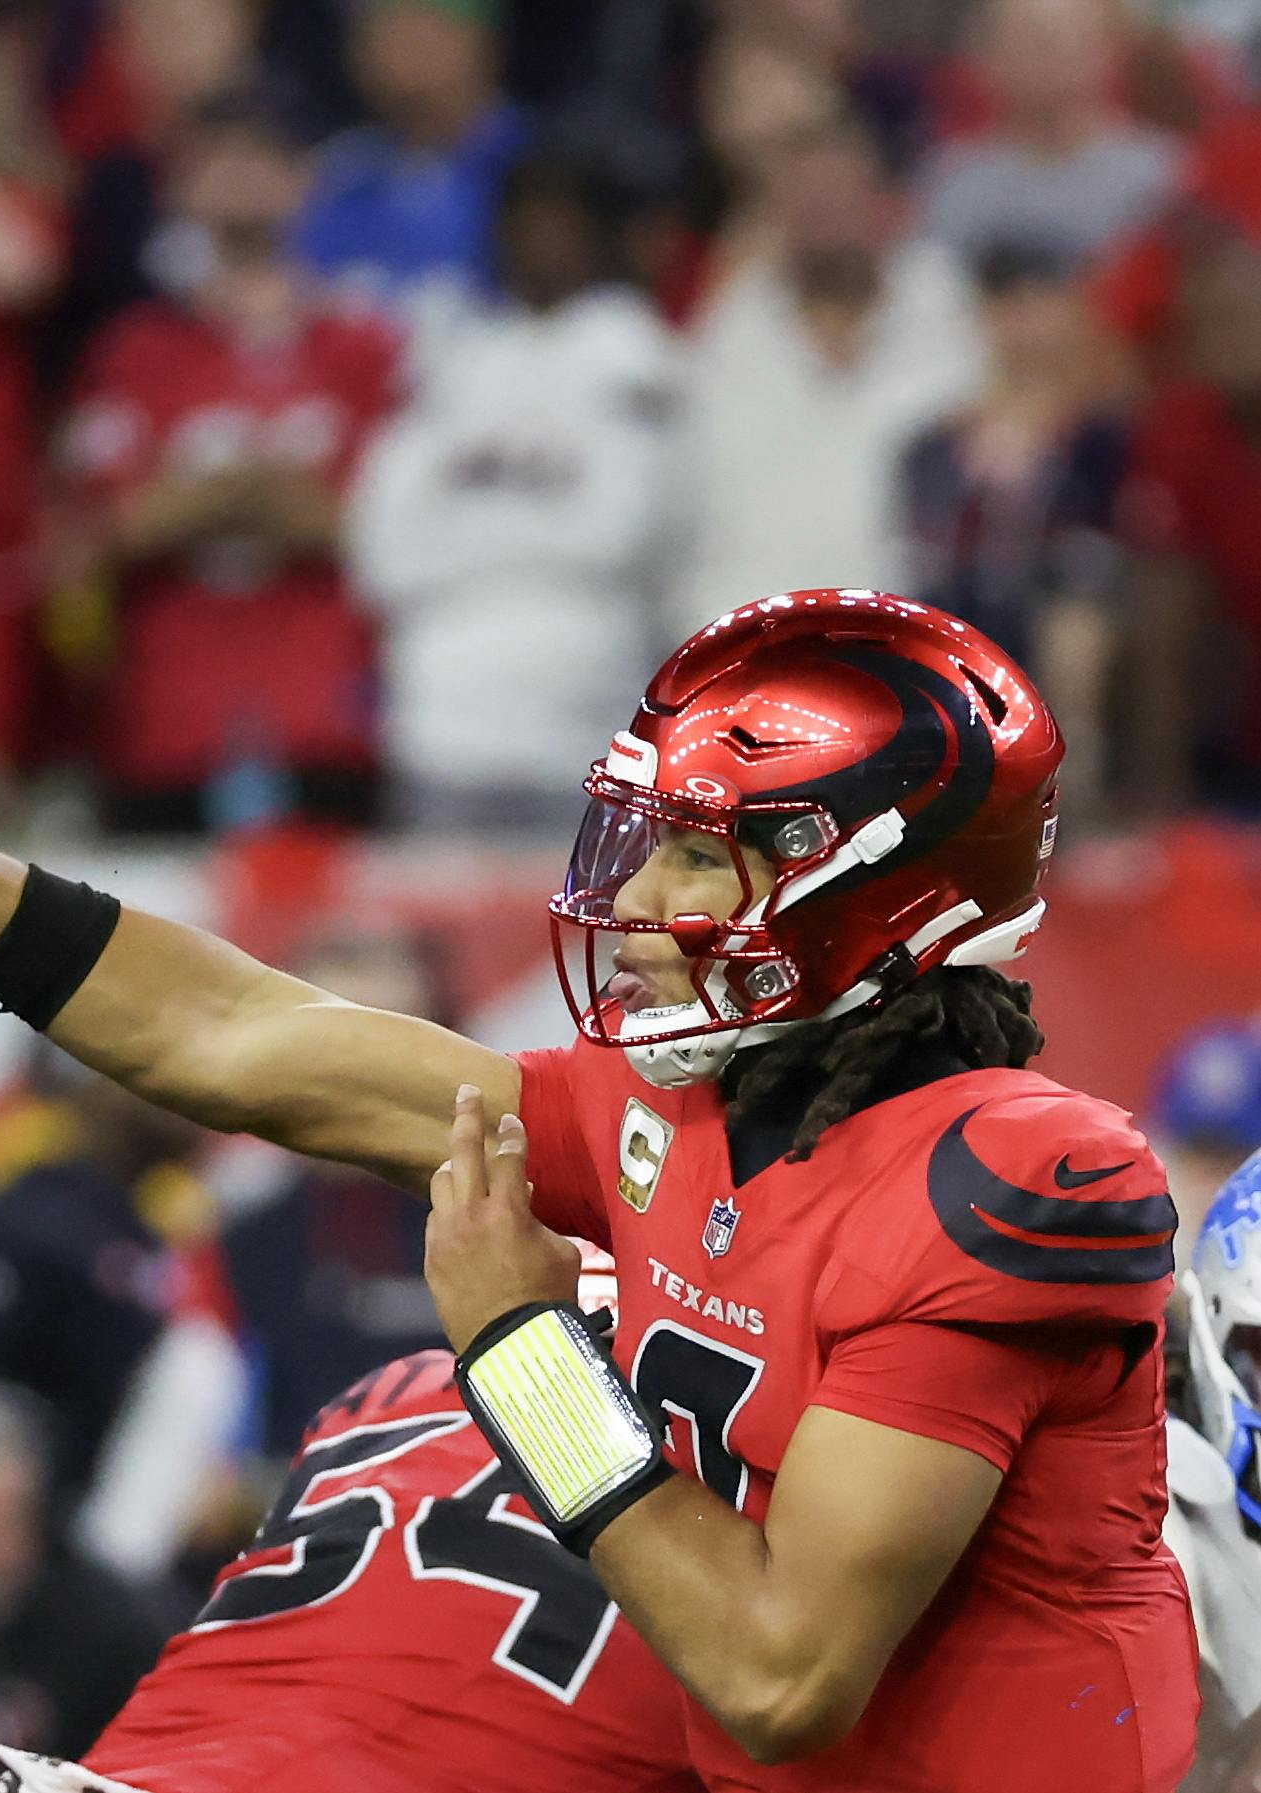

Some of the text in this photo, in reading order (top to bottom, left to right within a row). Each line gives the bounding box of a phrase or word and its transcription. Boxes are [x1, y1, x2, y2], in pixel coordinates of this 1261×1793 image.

[620, 1108, 665, 1186] C
[647, 1257, 766, 1336] TEXANS
[188, 1409, 620, 1706] 54
